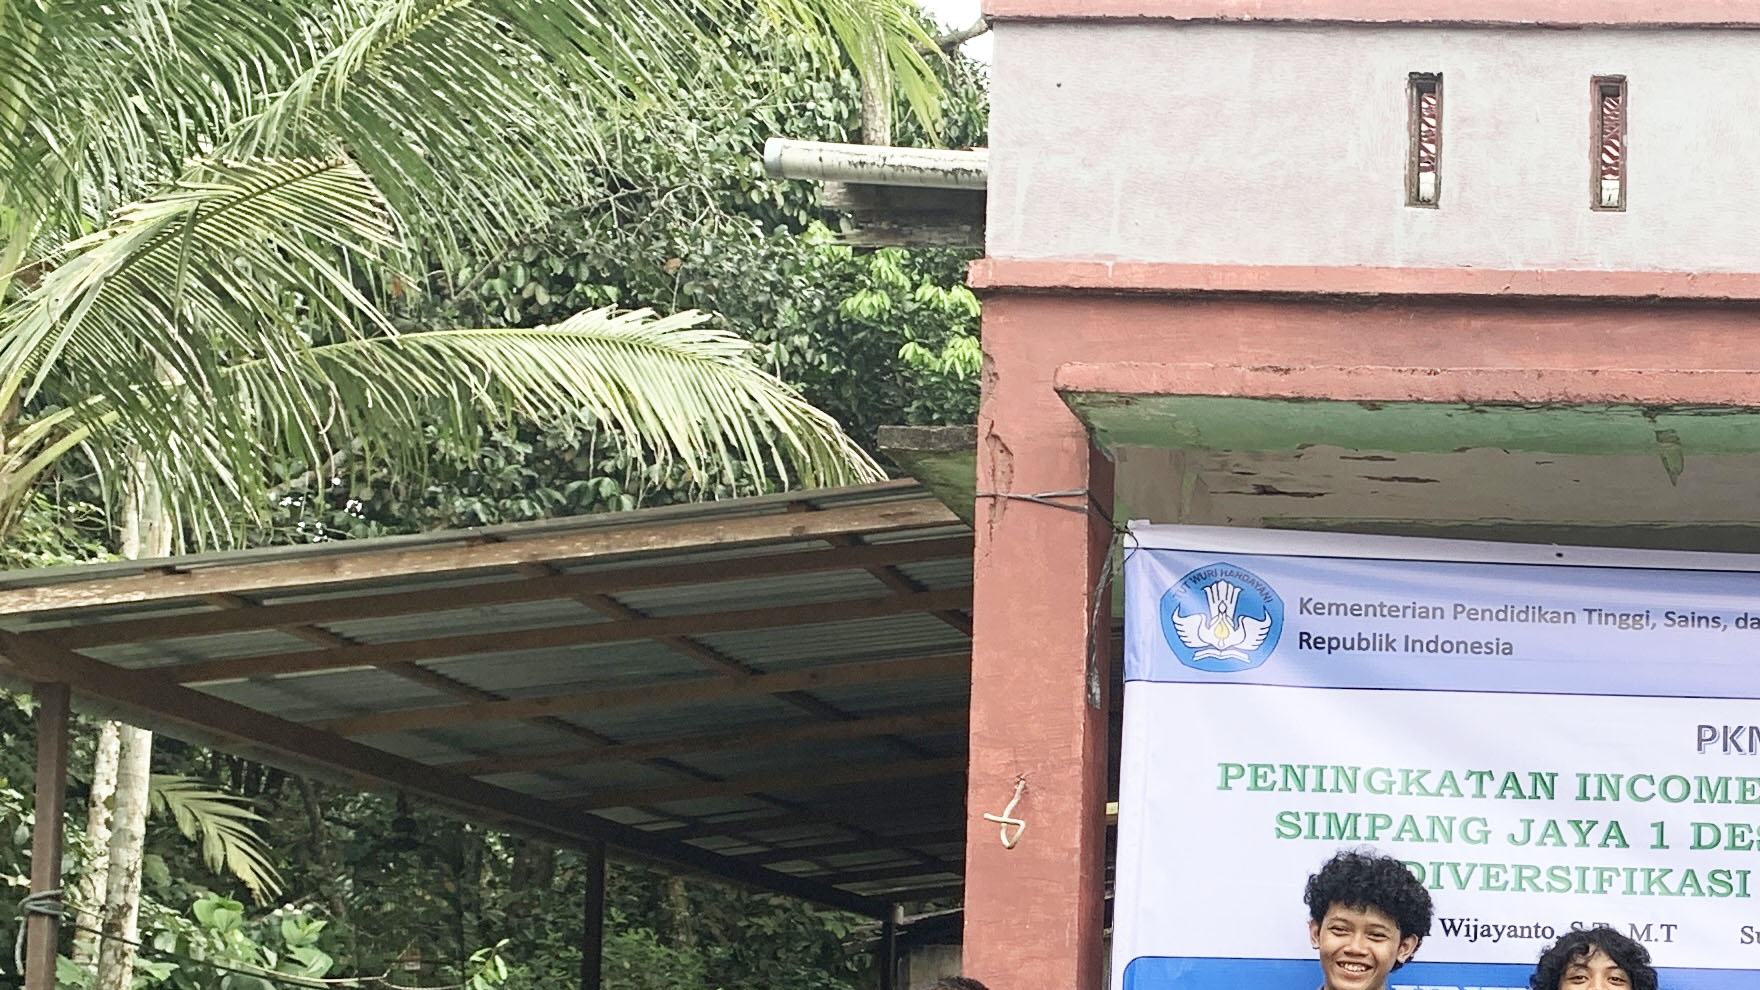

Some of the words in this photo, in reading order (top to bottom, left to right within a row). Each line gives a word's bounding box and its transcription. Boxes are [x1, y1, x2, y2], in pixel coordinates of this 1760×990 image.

[1190, 568, 1217, 586] WURI
[1299, 598, 1444, 619] Kementerian
[1453, 604, 1576, 624] Pendidikan
[1583, 608, 1656, 630] Tinggi,
[1664, 611, 1728, 631] Sains,
[1299, 631, 1397, 654] Republik
[1404, 634, 1513, 655] Indonesia
[1216, 762, 1558, 800] PENINGKATAN
[1275, 811, 1492, 844] SIMPANG
[1507, 818, 1629, 848] JAYA
[1650, 821, 1670, 850] 1
[1438, 917, 1561, 943] Wijayanto,
